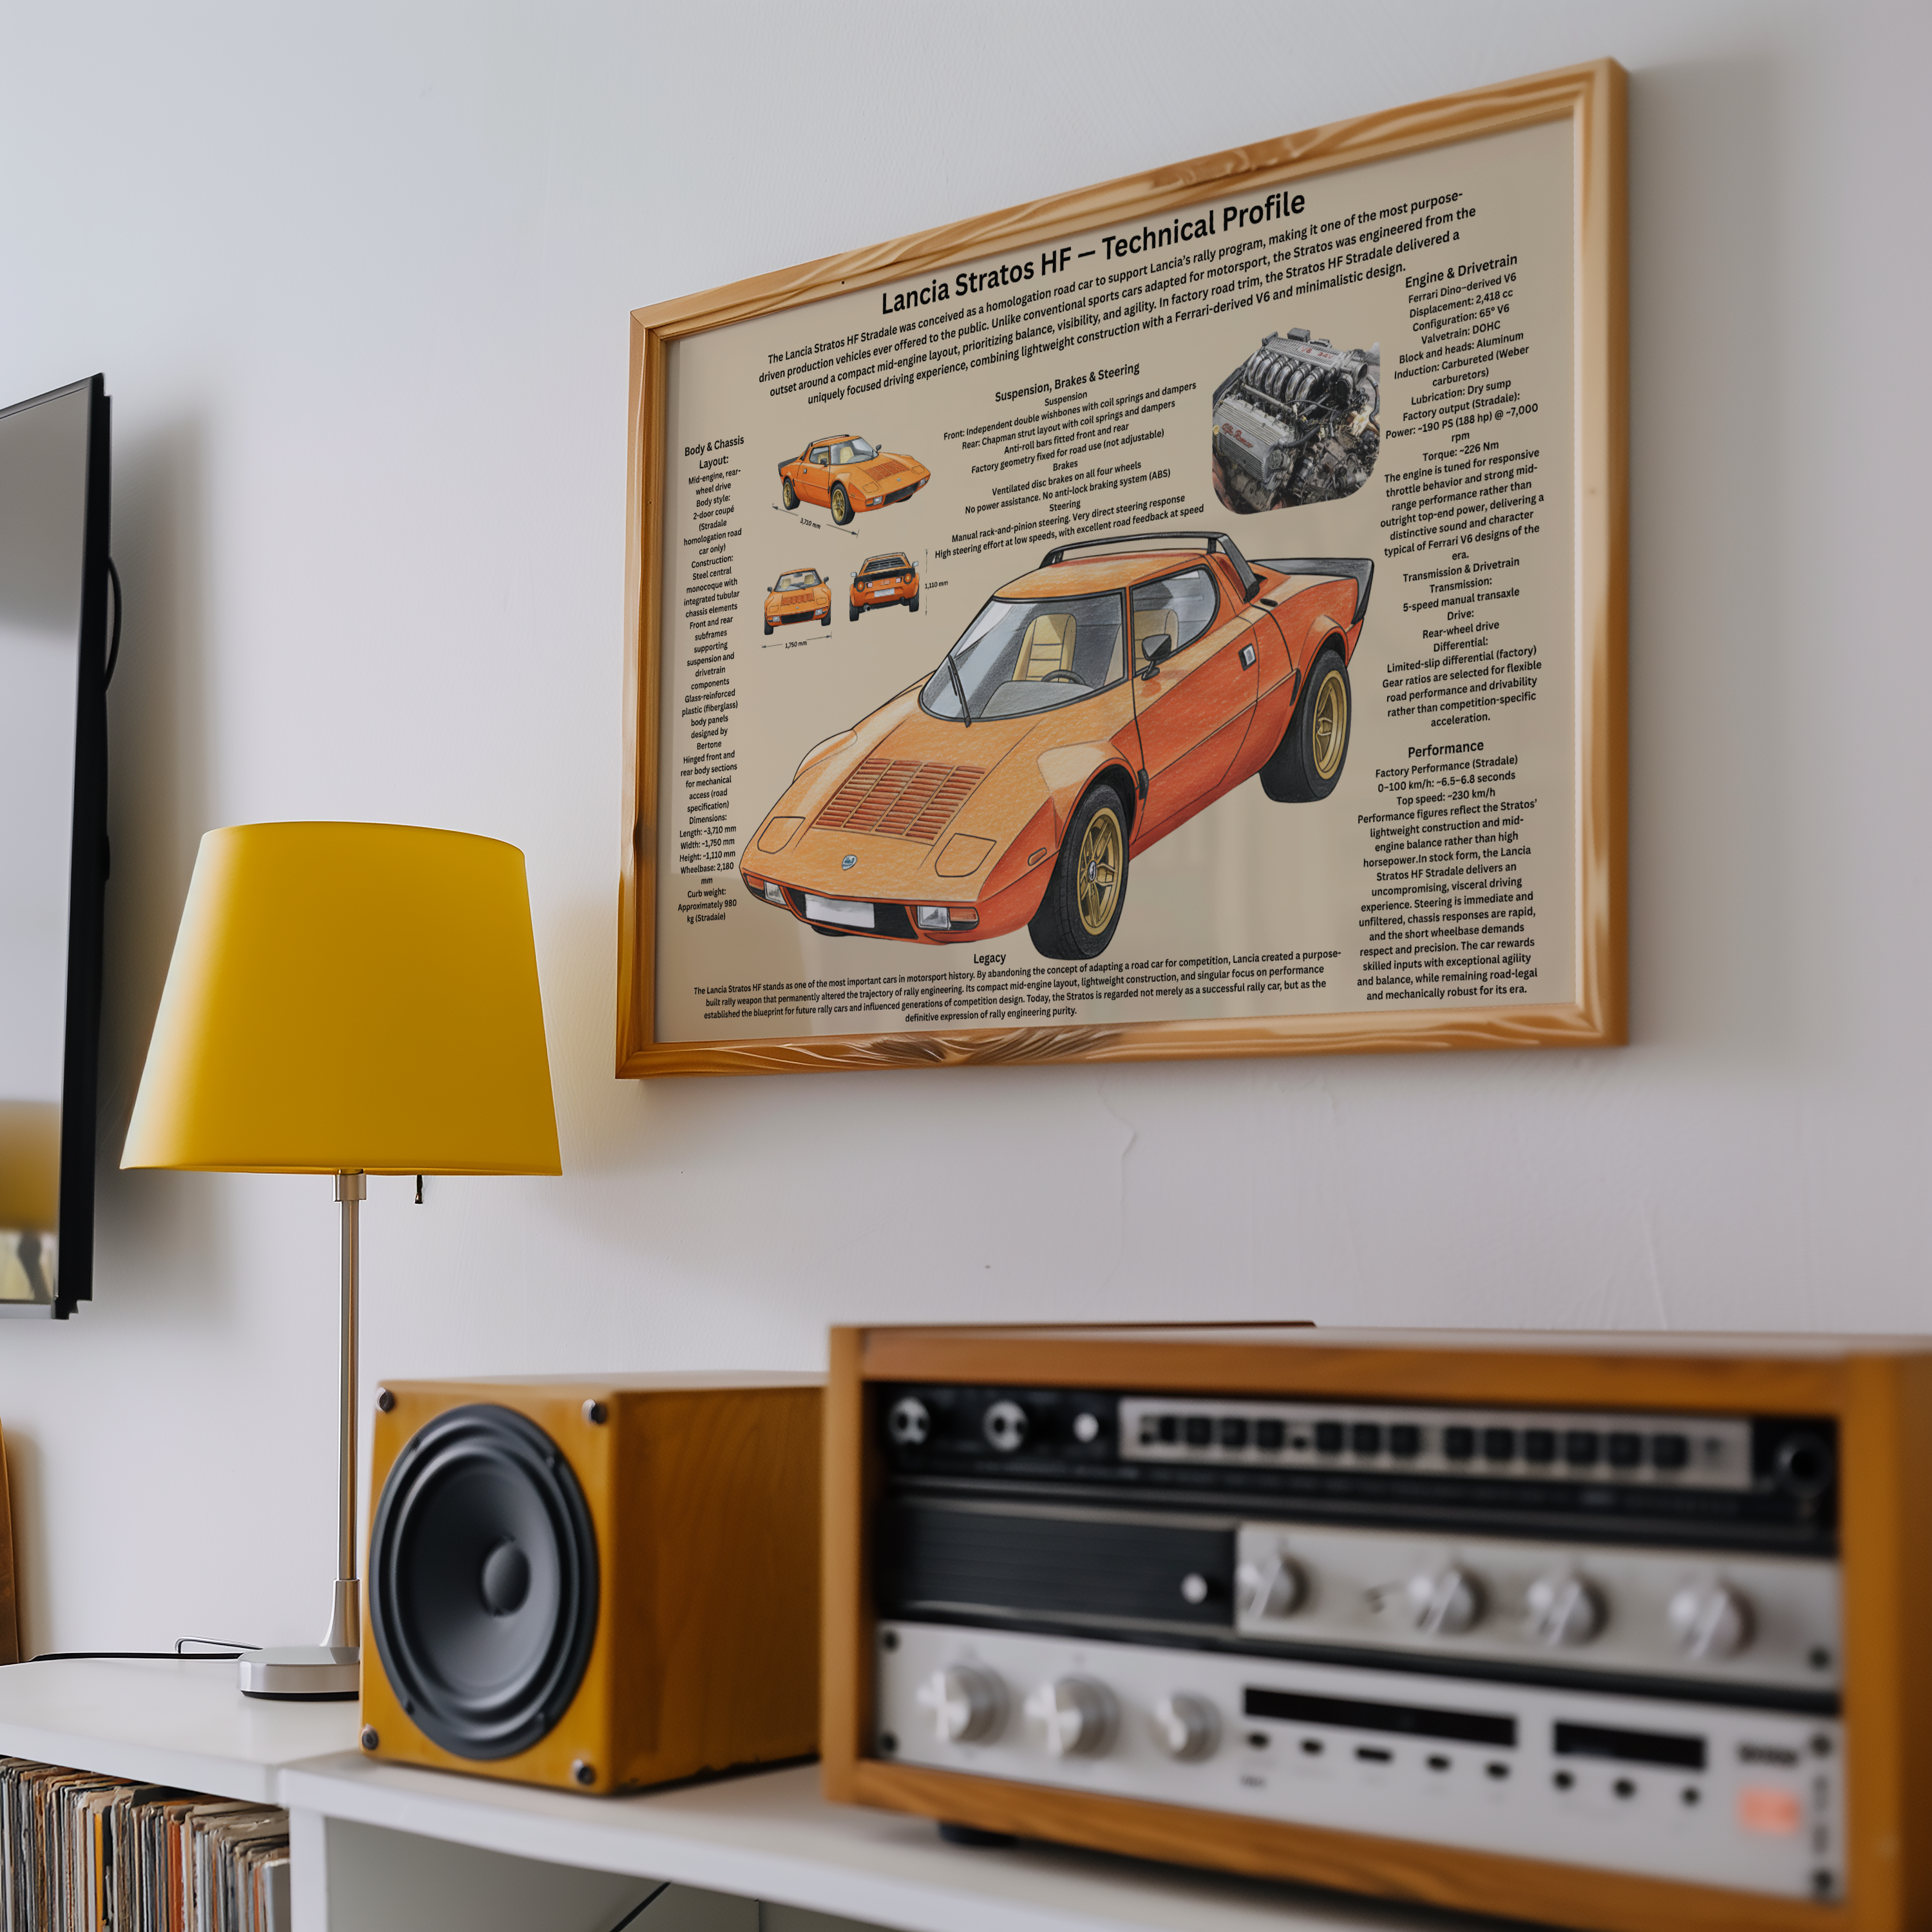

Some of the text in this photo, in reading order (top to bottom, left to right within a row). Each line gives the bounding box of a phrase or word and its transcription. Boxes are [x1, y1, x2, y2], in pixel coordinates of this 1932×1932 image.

[882, 279, 949, 314] Lancia
[955, 261, 1034, 296] Stratos
[1041, 246, 1071, 276] HF
[1102, 210, 1215, 260] Technical
[1223, 191, 1304, 231] Profile
[768, 353, 783, 364] The
[785, 345, 812, 360] Lancia
[814, 339, 844, 353] Stratos
[847, 334, 858, 345] HF
[860, 325, 897, 342] Stradale
[899, 322, 915, 333] was
[918, 308, 963, 328] conceived
[966, 308, 976, 317] as
[986, 290, 1050, 312] homologation
[1054, 281, 1075, 296] road
[1078, 279, 1093, 290] car
[1095, 276, 1106, 286] to
[1108, 265, 1148, 283] support
[1193, 249, 1216, 263] rally
[1218, 239, 1265, 260] program,
[1269, 227, 1307, 245] making
[1310, 224, 1318, 235] it
[1320, 220, 1341, 232] one
[1343, 213, 1356, 227] of
[1358, 211, 1376, 223] the
[1379, 203, 1407, 218] most
[1411, 192, 1463, 214] purpose-
[1405, 254, 1517, 288] Engine & Drivetrain
[1410, 290, 1513, 317] Displacement: 2,418 cc
[1412, 312, 1477, 331] Configuration:
[1497, 303, 1509, 314] V6
[808, 388, 845, 404] uniquely
[846, 378, 881, 395] focused
[883, 373, 914, 387] driving
[916, 362, 968, 380] experience,
[970, 348, 1019, 367] combining
[1021, 336, 1074, 358] lightweight
[1077, 323, 1139, 344] construction
[1142, 315, 1164, 329] with
[1175, 294, 1253, 322] Ferrari-derived
[1255, 290, 1269, 303] V6
[1273, 285, 1292, 300] and
[1296, 270, 1363, 295] minimalistic
[1365, 263, 1405, 279] design.
[1421, 320, 1500, 344] Valvetrain: DOHC
[1399, 332, 1523, 364] Block and heads: Aluminum
[995, 363, 1139, 402] Suspension, Brakes & Steering
[1045, 392, 1087, 406] Suspension
[1386, 427, 1415, 439] Power:
[1442, 419, 1453, 429] PS
[1455, 414, 1475, 427] (188
[1477, 411, 1492, 423] hp)
[1494, 410, 1503, 420] @
[685, 435, 744, 456] Body & Chassis
[1004, 423, 1129, 454] Anti-roll bars fitted front and rear
[1423, 449, 1457, 461] Torque:
[1483, 441, 1498, 451] Nm
[699, 455, 728, 469] Layout:
[688, 472, 724, 484] Mid-engine,
[965, 468, 1170, 514] No power assistance. No anti-lock braking system (ABS)
[693, 504, 734, 520] 2-door coupé
[800, 518, 811, 526] 3,710
[691, 555, 733, 568] Construction:
[1403, 557, 1519, 582] Transmission & Drivetrain
[1403, 587, 1519, 612] 5-speed manual transaxle
[1387, 645, 1536, 672] Limited-slip differential (factory)
[685, 688, 735, 703] Glass-reinforced
[682, 700, 737, 717] plastic (fiberglass)
[697, 741, 721, 750] Bertone
[1408, 742, 1484, 758] Performance
[683, 750, 735, 764] Hinged front and
[1376, 754, 1517, 777] Factory Performance (Stradale)
[1396, 796, 1413, 806] Top
[1416, 792, 1445, 806] speed:
[1472, 787, 1495, 798] km/h
[687, 800, 728, 813] specification)
[679, 828, 702, 838] Length:
[680, 840, 700, 849] Width:
[679, 853, 701, 862] Height:
[680, 862, 734, 873] Wheelbase: 2,180
[1359, 946, 1393, 958] respect
[1395, 944, 1411, 954] and
[1414, 942, 1458, 955] precision.
[1461, 940, 1477, 950] The
[1497, 937, 1534, 948] rewards
[974, 954, 1006, 965] Legacy
[905, 1006, 1076, 1021] definitive expression of rally engineering purity.
